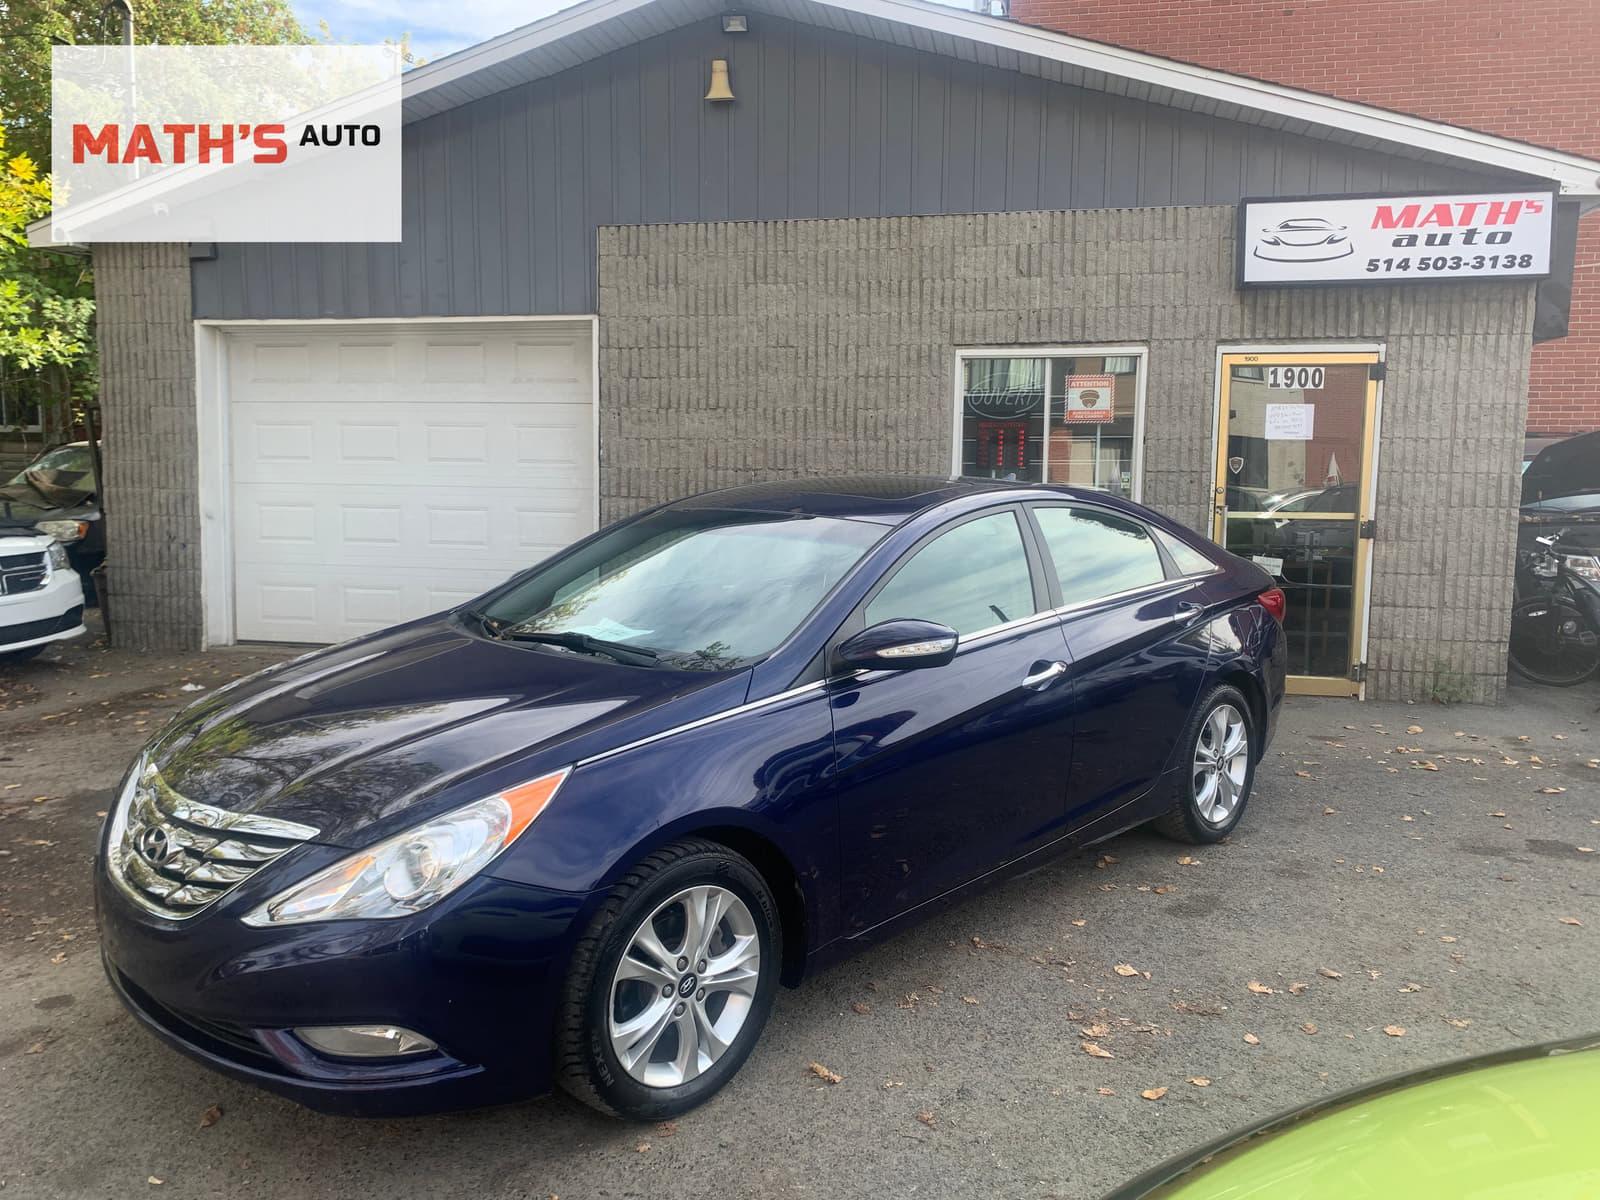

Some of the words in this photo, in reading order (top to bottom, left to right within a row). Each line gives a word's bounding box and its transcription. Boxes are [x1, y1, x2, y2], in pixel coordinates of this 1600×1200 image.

[1391, 228, 1513, 248] auto
[1365, 257, 1411, 273] 514
[1416, 254, 1533, 272] 503-3138
[1070, 380, 1108, 388] ATTENTION
[1269, 367, 1323, 388] 1900
[971, 386, 1031, 406] OUVERT
